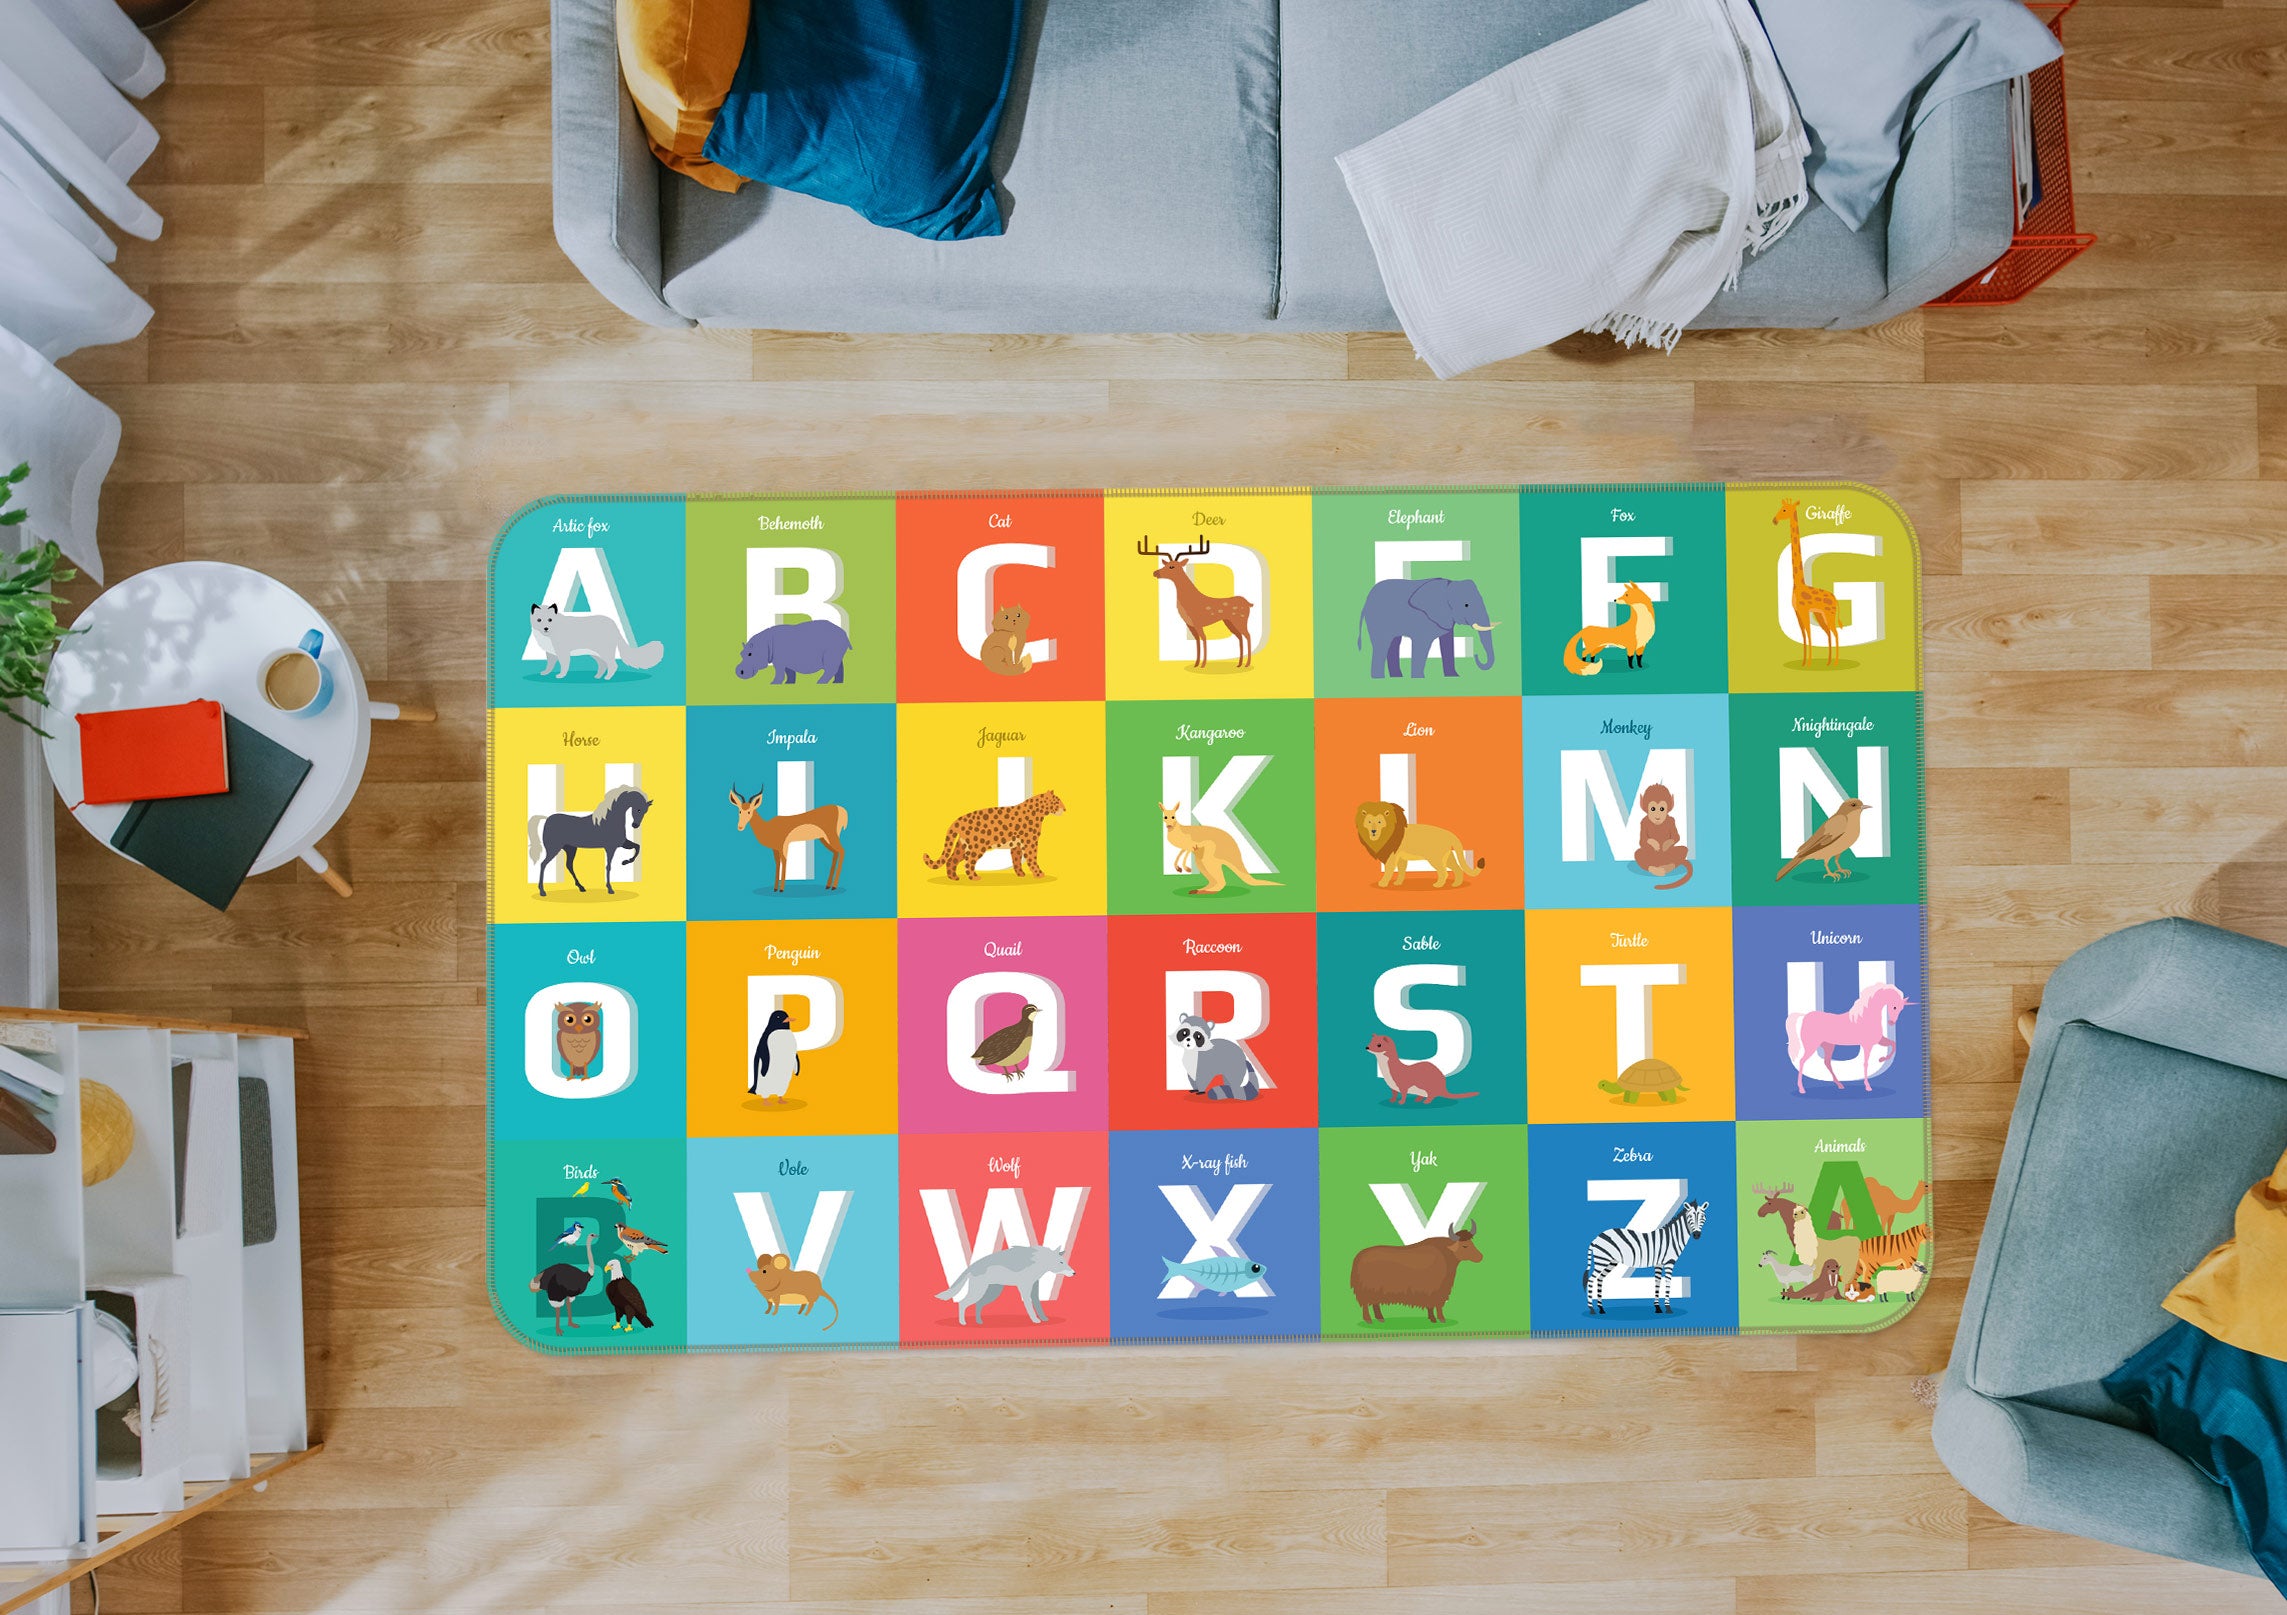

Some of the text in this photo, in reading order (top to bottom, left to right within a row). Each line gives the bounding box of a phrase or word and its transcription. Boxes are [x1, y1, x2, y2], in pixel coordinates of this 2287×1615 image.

[758, 515, 824, 530] Behemoth
[989, 514, 1012, 528] Cat
[1192, 511, 1226, 526] Deer
[1388, 509, 1445, 530] Elephant
[1611, 508, 1636, 522] Fox
[1806, 504, 1852, 526] Giraffe
[553, 517, 610, 538] Artic fox
[1580, 536, 1673, 649] F
[1777, 533, 1885, 648] G
[522, 547, 638, 661] A
[746, 547, 850, 667] B
[956, 542, 1056, 663] C
[1158, 543, 1271, 661] D
[977, 727, 1026, 748] Jaguar
[1176, 724, 1246, 745] Kangaroo
[1403, 722, 1435, 736] Lion
[1600, 718, 1653, 740] Monkey
[1792, 716, 1874, 738] Nnightingale
[563, 731, 600, 747] Horse
[767, 729, 818, 750] Impala
[1560, 748, 1695, 862] M
[1779, 746, 1890, 859] N
[527, 763, 641, 884] H
[777, 760, 815, 881] I
[1162, 755, 1280, 875] K
[1183, 938, 1242, 956] Raccoon
[1402, 936, 1441, 950] Sable
[1610, 932, 1648, 947] Turtle
[1810, 931, 1863, 944] Unicorn
[567, 949, 596, 964] Owl
[764, 944, 821, 966] Penguin
[984, 941, 1022, 958] Quail
[1165, 970, 1278, 1091] R
[1373, 964, 1472, 1080] S
[1580, 963, 1687, 1081] T
[1786, 960, 1896, 1081] U
[524, 982, 638, 1099] O
[747, 974, 844, 1097] P
[946, 971, 1076, 1095] Q
[1613, 1147, 1653, 1162] Zebra
[1814, 1138, 1866, 1152] Animals
[563, 1164, 599, 1179] Birds
[778, 1159, 809, 1176] Vole
[988, 1157, 1021, 1179] Wolf
[1182, 1154, 1248, 1175] X-ray fish
[1410, 1151, 1437, 1172] Yak
[1790, 1160, 1899, 1281] A
[733, 1190, 855, 1307] V
[918, 1186, 1092, 1303] W
[1157, 1184, 1276, 1299] X
[1587, 1178, 1691, 1300] Z
[536, 1196, 632, 1318] B
